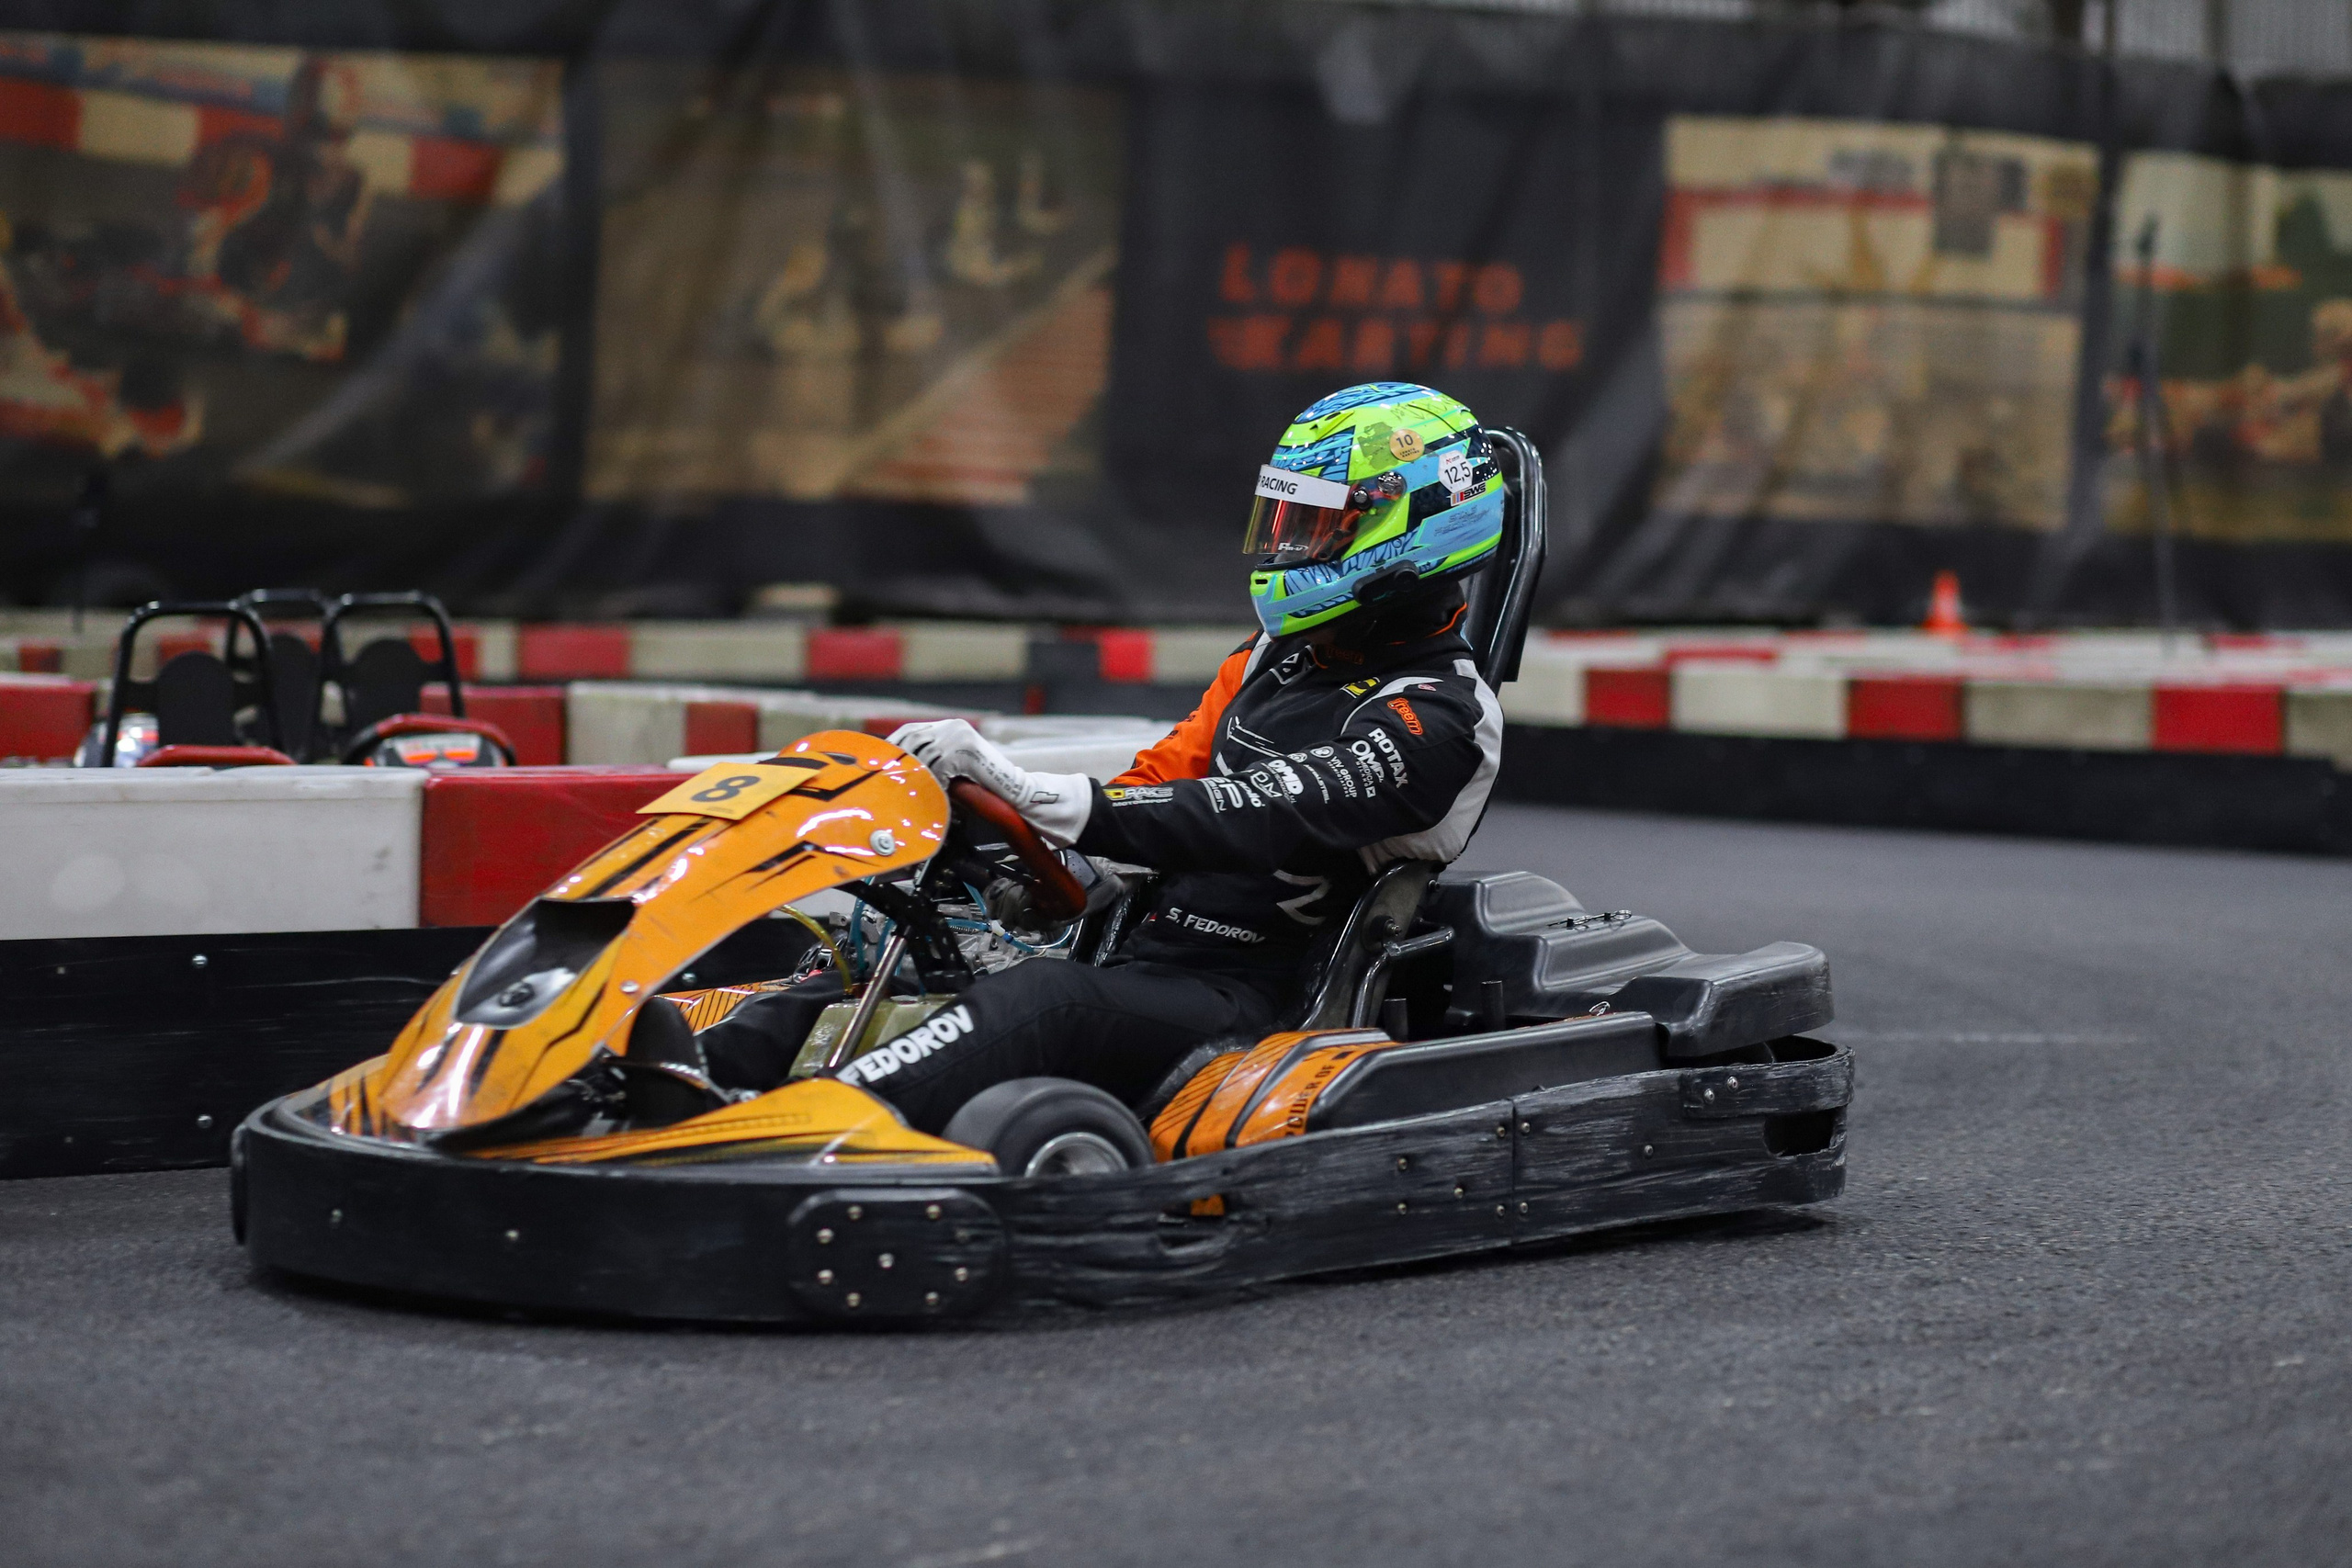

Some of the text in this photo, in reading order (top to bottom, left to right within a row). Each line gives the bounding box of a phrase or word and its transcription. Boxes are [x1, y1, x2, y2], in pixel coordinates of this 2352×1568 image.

[1218, 241, 1524, 314] LONATO
[1207, 315, 1586, 370] KARTING
[1396, 434, 1414, 448] 10
[1261, 476, 1298, 495] RACING
[1444, 461, 1470, 484] 12,5
[1387, 697, 1423, 735] freem
[1368, 728, 1408, 788] ROTAX
[690, 775, 761, 802] 8
[1340, 768, 1357, 797] GROUP
[1183, 914, 1266, 943] FEDOROV
[836, 1004, 974, 1087] FEDOROV
